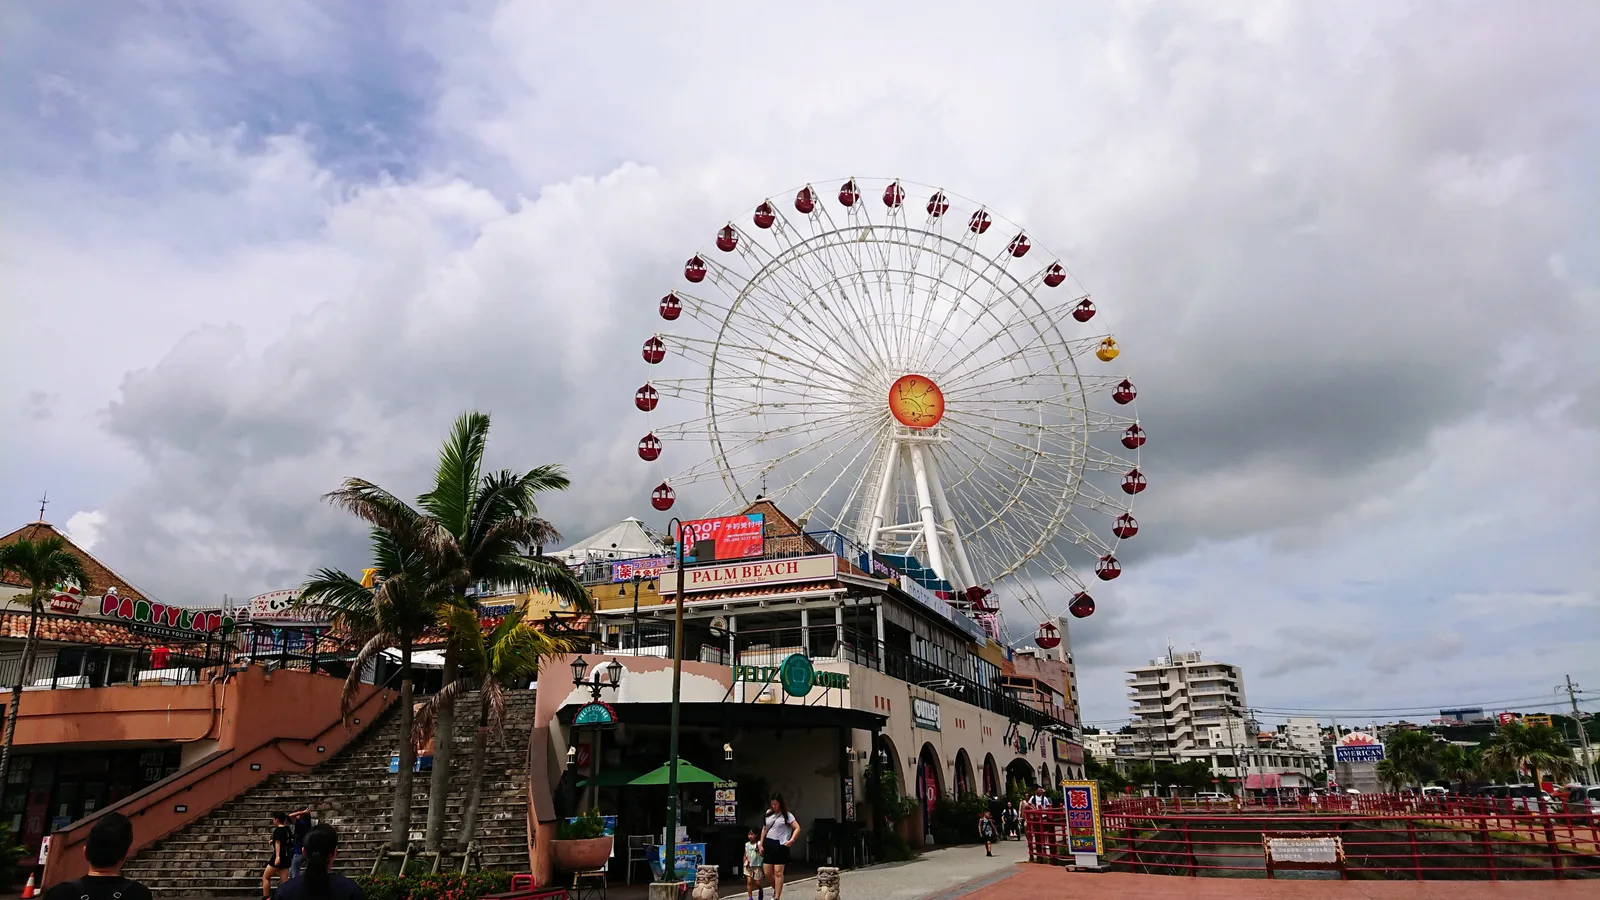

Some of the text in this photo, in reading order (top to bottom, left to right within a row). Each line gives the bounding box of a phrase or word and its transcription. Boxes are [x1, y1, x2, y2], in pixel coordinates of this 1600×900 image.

[618, 563, 633, 579] 薬
[692, 562, 798, 583] PALM BEACH
[102, 594, 236, 634] PARTYLAND
[143, 626, 196, 639] FROZEN YOGURT
[733, 665, 780, 683] FELIZ
[1068, 790, 1088, 809] 薬
